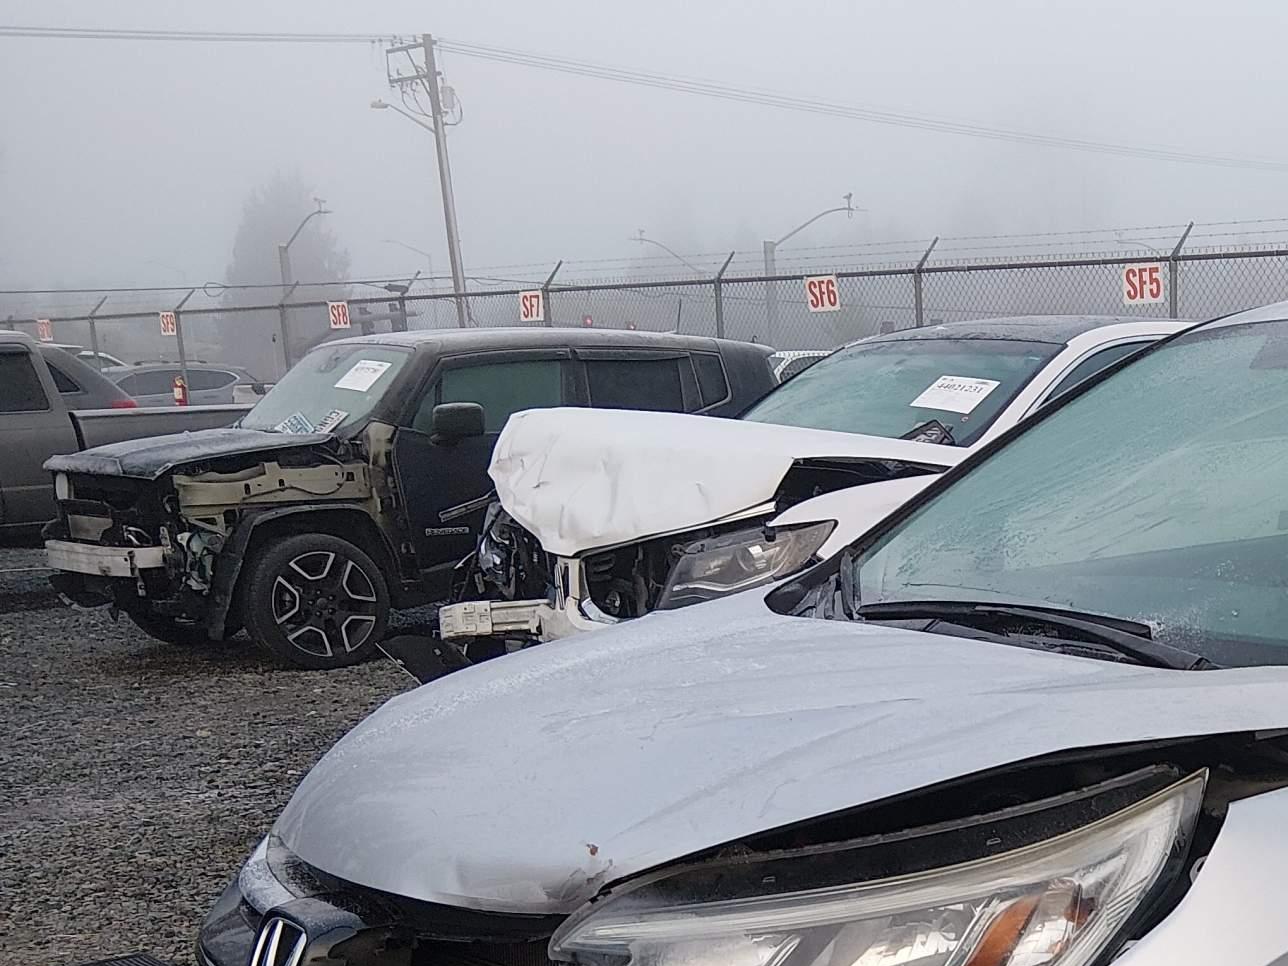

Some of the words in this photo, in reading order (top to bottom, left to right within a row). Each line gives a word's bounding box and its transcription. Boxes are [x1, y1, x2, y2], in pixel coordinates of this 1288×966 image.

[808, 279, 837, 308] SF6
[1125, 266, 1161, 300] SF5
[331, 303, 349, 326] SF8
[522, 294, 541, 320] SF7
